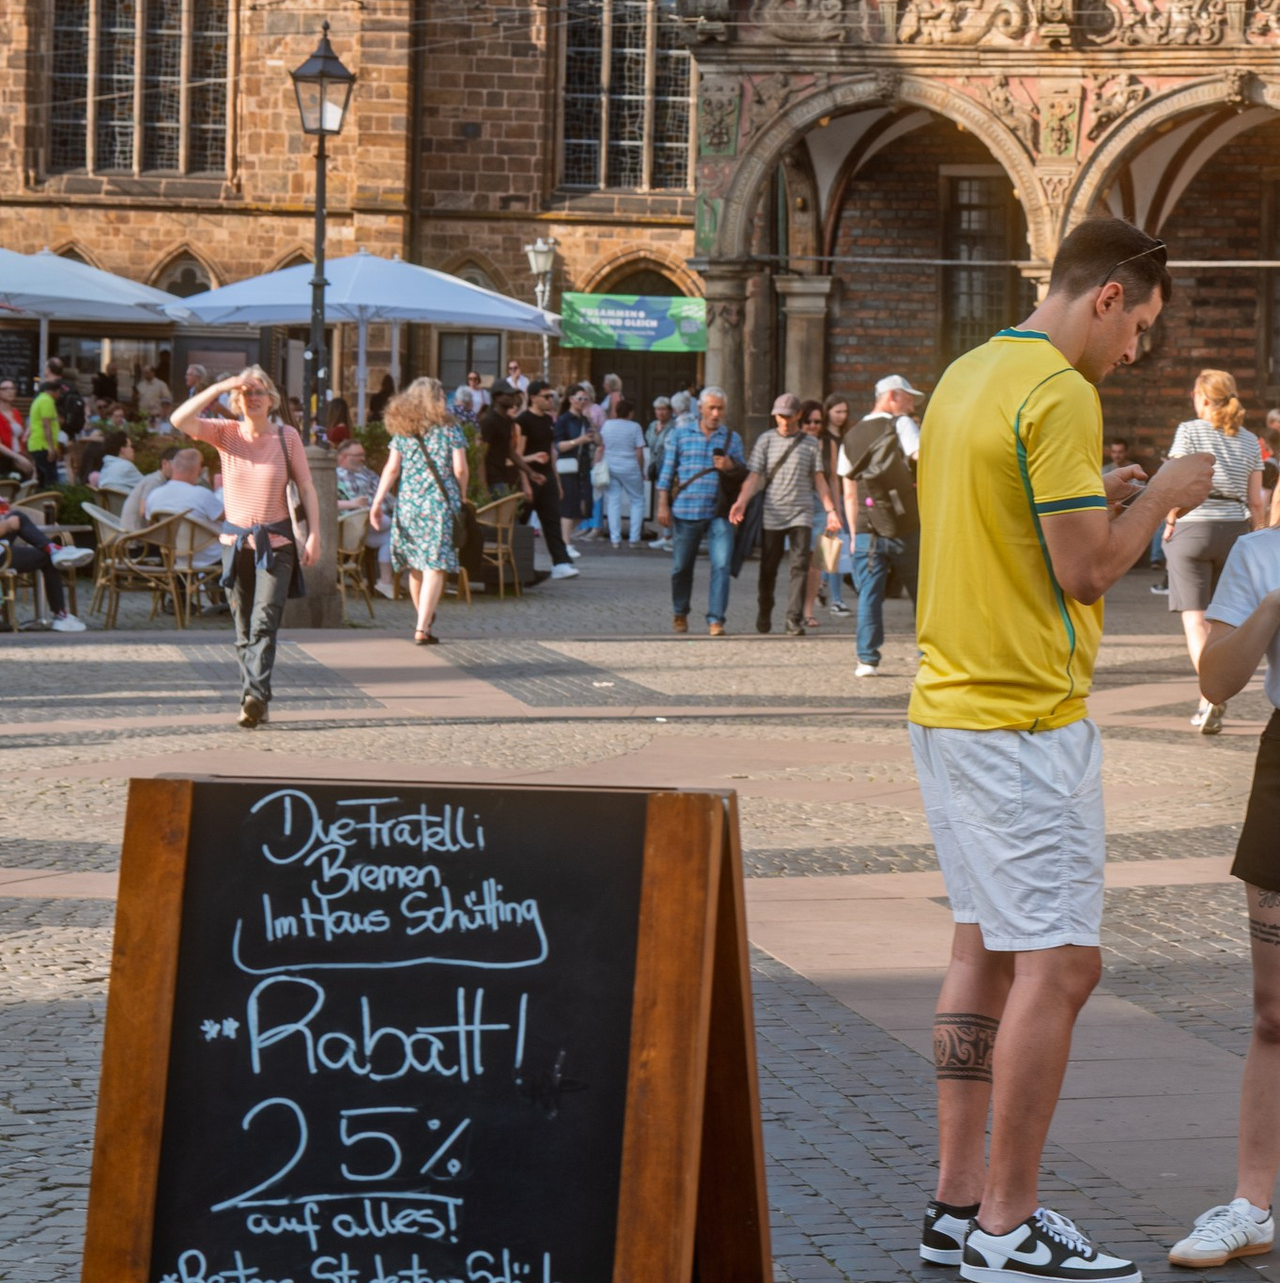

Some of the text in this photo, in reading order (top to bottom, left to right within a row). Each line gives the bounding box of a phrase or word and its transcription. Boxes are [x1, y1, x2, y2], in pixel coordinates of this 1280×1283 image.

[304, 844, 442, 900] Bremen
[246, 1198, 462, 1252] auf alles!
